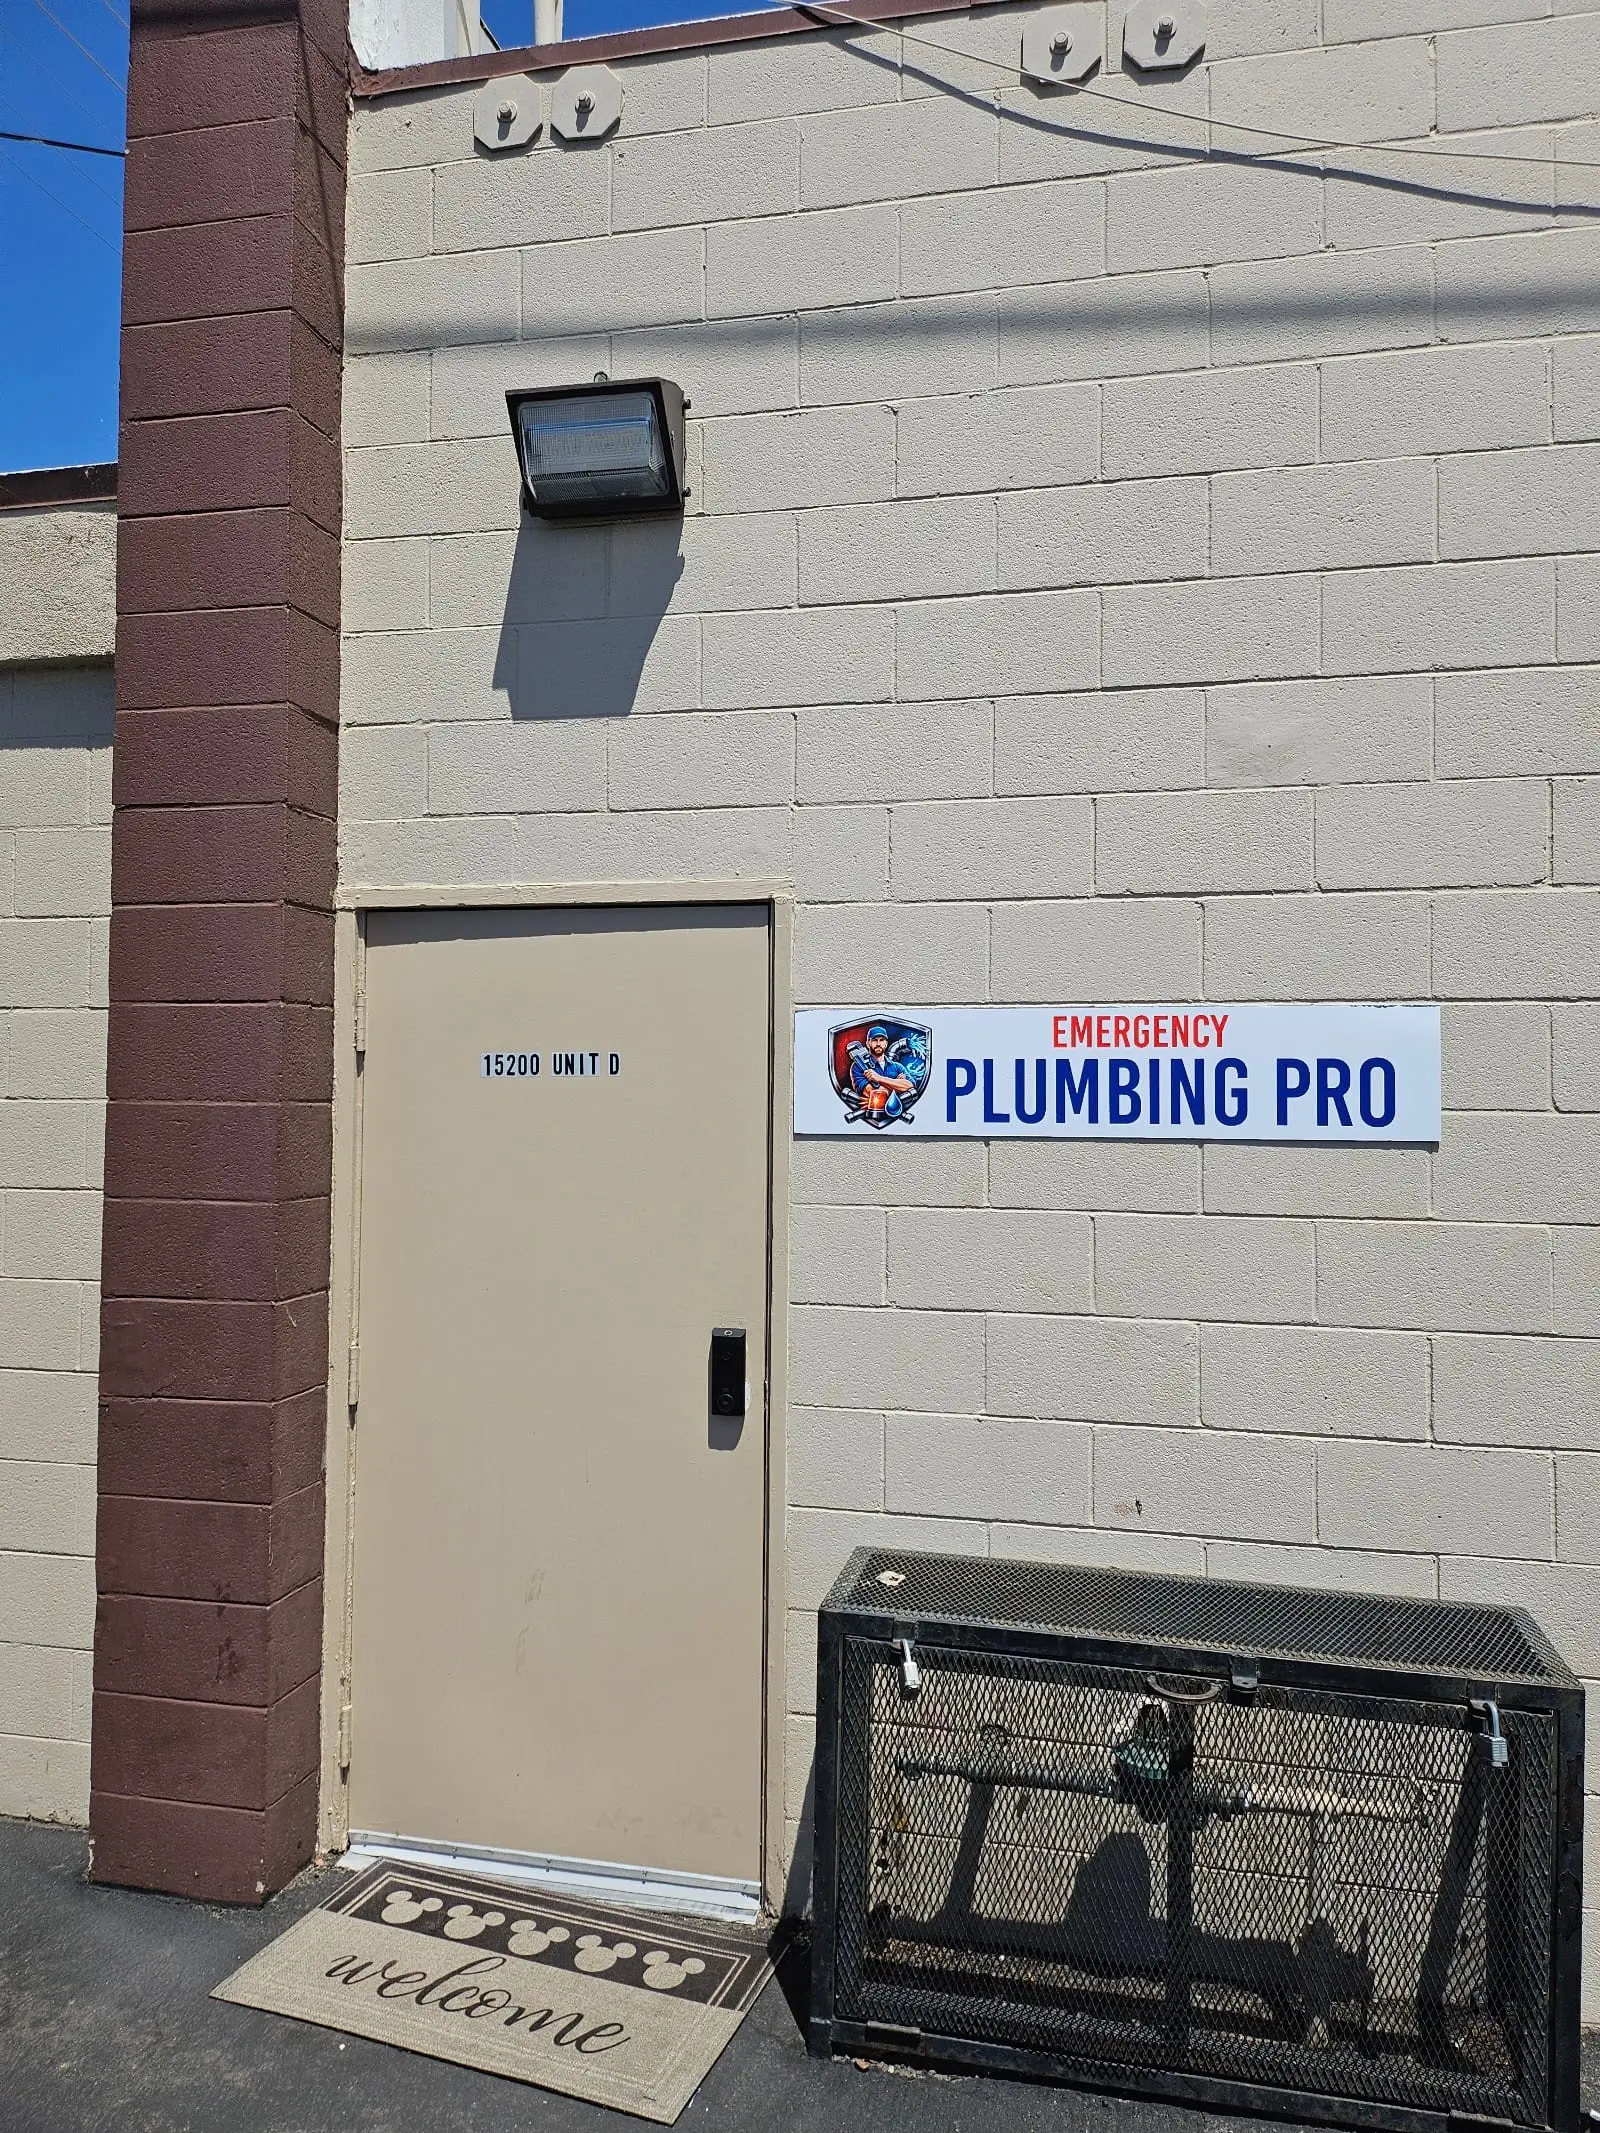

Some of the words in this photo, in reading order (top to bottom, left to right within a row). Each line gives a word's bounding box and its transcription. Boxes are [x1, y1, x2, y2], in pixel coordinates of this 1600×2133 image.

[1052, 1014, 1230, 1049] EMERGENCY
[483, 1053, 540, 1076] 15200
[553, 1052, 599, 1075] UNIT
[609, 1053, 620, 1075] D
[946, 1057, 1249, 1127] PLUMBING
[1276, 1056, 1397, 1128] PRO
[325, 1954, 631, 2054] welcome
